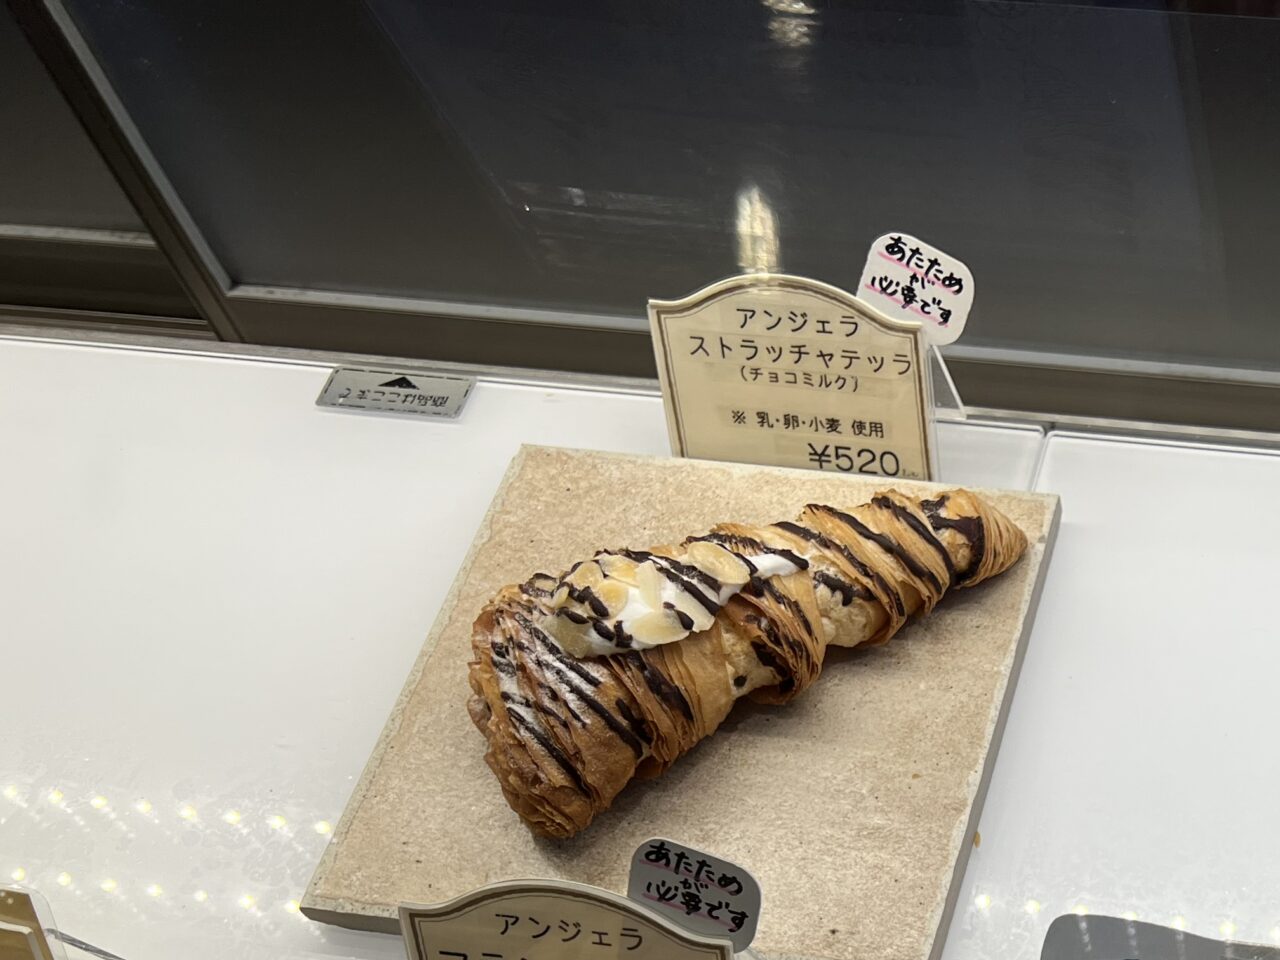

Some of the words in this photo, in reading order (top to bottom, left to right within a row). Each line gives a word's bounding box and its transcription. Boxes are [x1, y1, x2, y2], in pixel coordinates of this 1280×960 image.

[884, 236, 963, 295] あたため
[871, 275, 952, 325] 必要です
[736, 308, 860, 337] アンジェラ
[688, 335, 912, 375] ストラッチャテッラ
[739, 366, 859, 392] （チョコミルク）
[808, 443, 900, 477] ¥520
[644, 841, 743, 896] あたため
[646, 880, 749, 932] 必要です
[495, 913, 643, 950] アンジェラ
